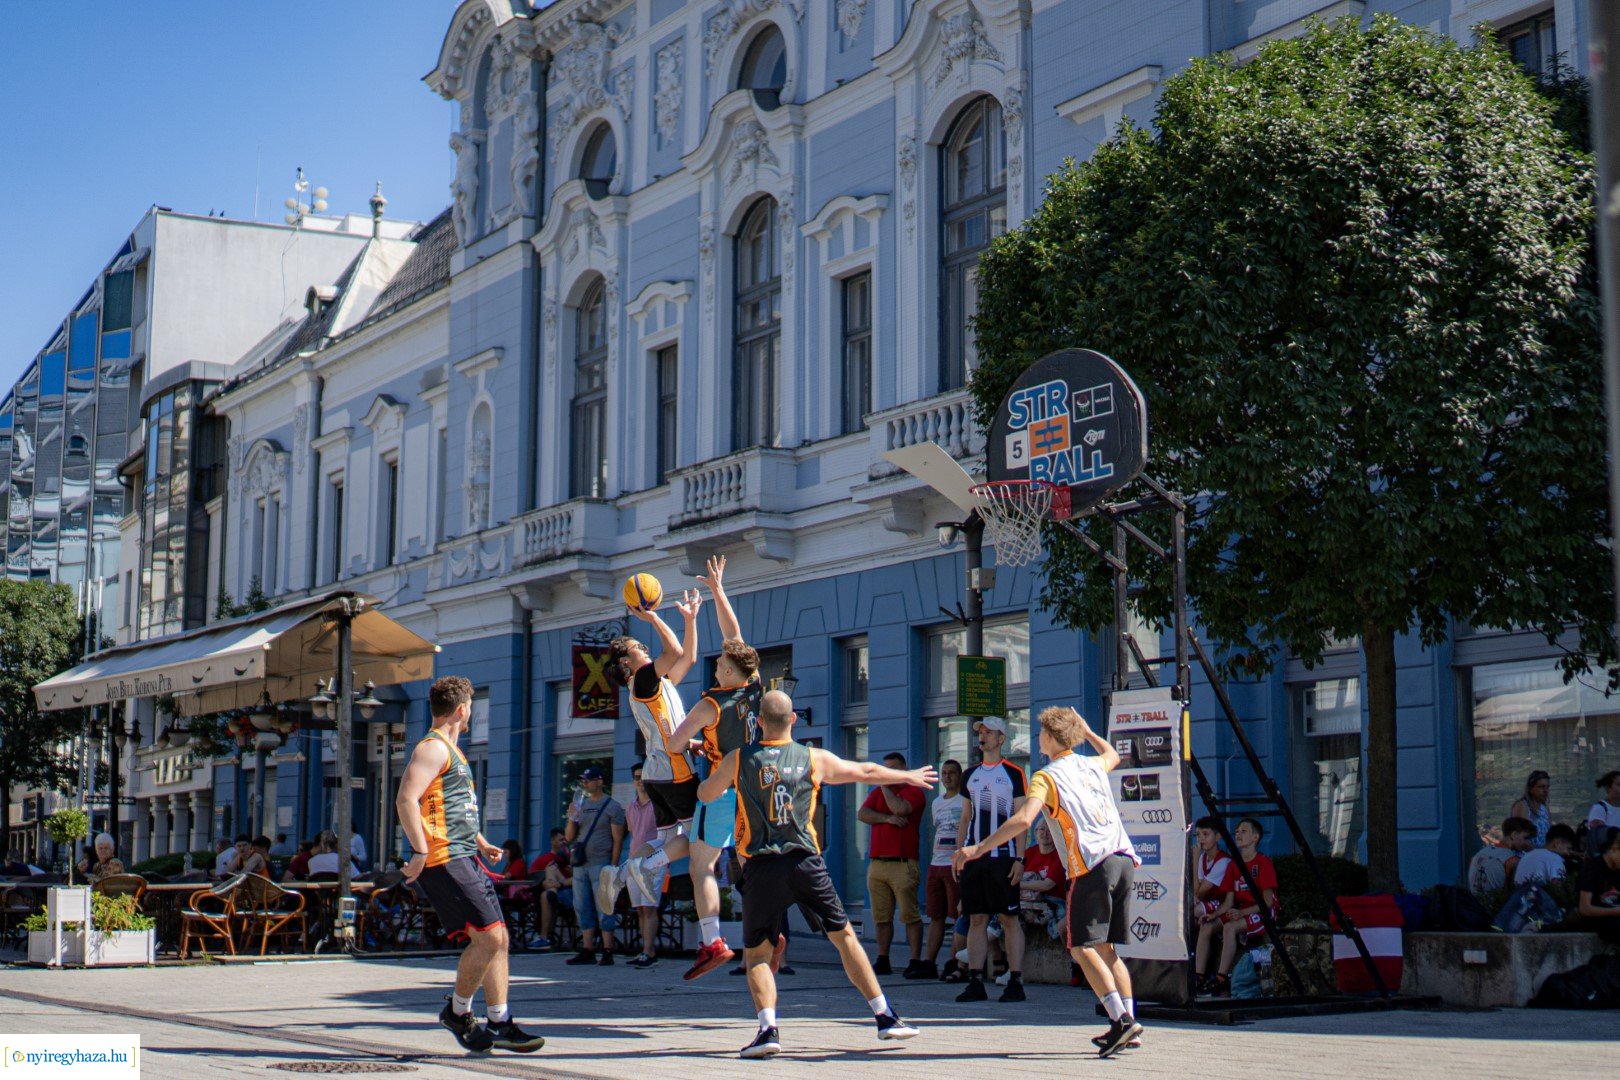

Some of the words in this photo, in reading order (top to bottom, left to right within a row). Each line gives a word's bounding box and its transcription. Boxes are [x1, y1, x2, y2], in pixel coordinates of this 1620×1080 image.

[1012, 440, 1023, 459] 5
[1029, 444, 1114, 491] BALL
[158, 673, 172, 691] PUB
[579, 653, 612, 693] X
[1132, 881, 1160, 891] OWER
[1137, 891, 1159, 900] ADE
[1136, 922, 1161, 938] TOTI
